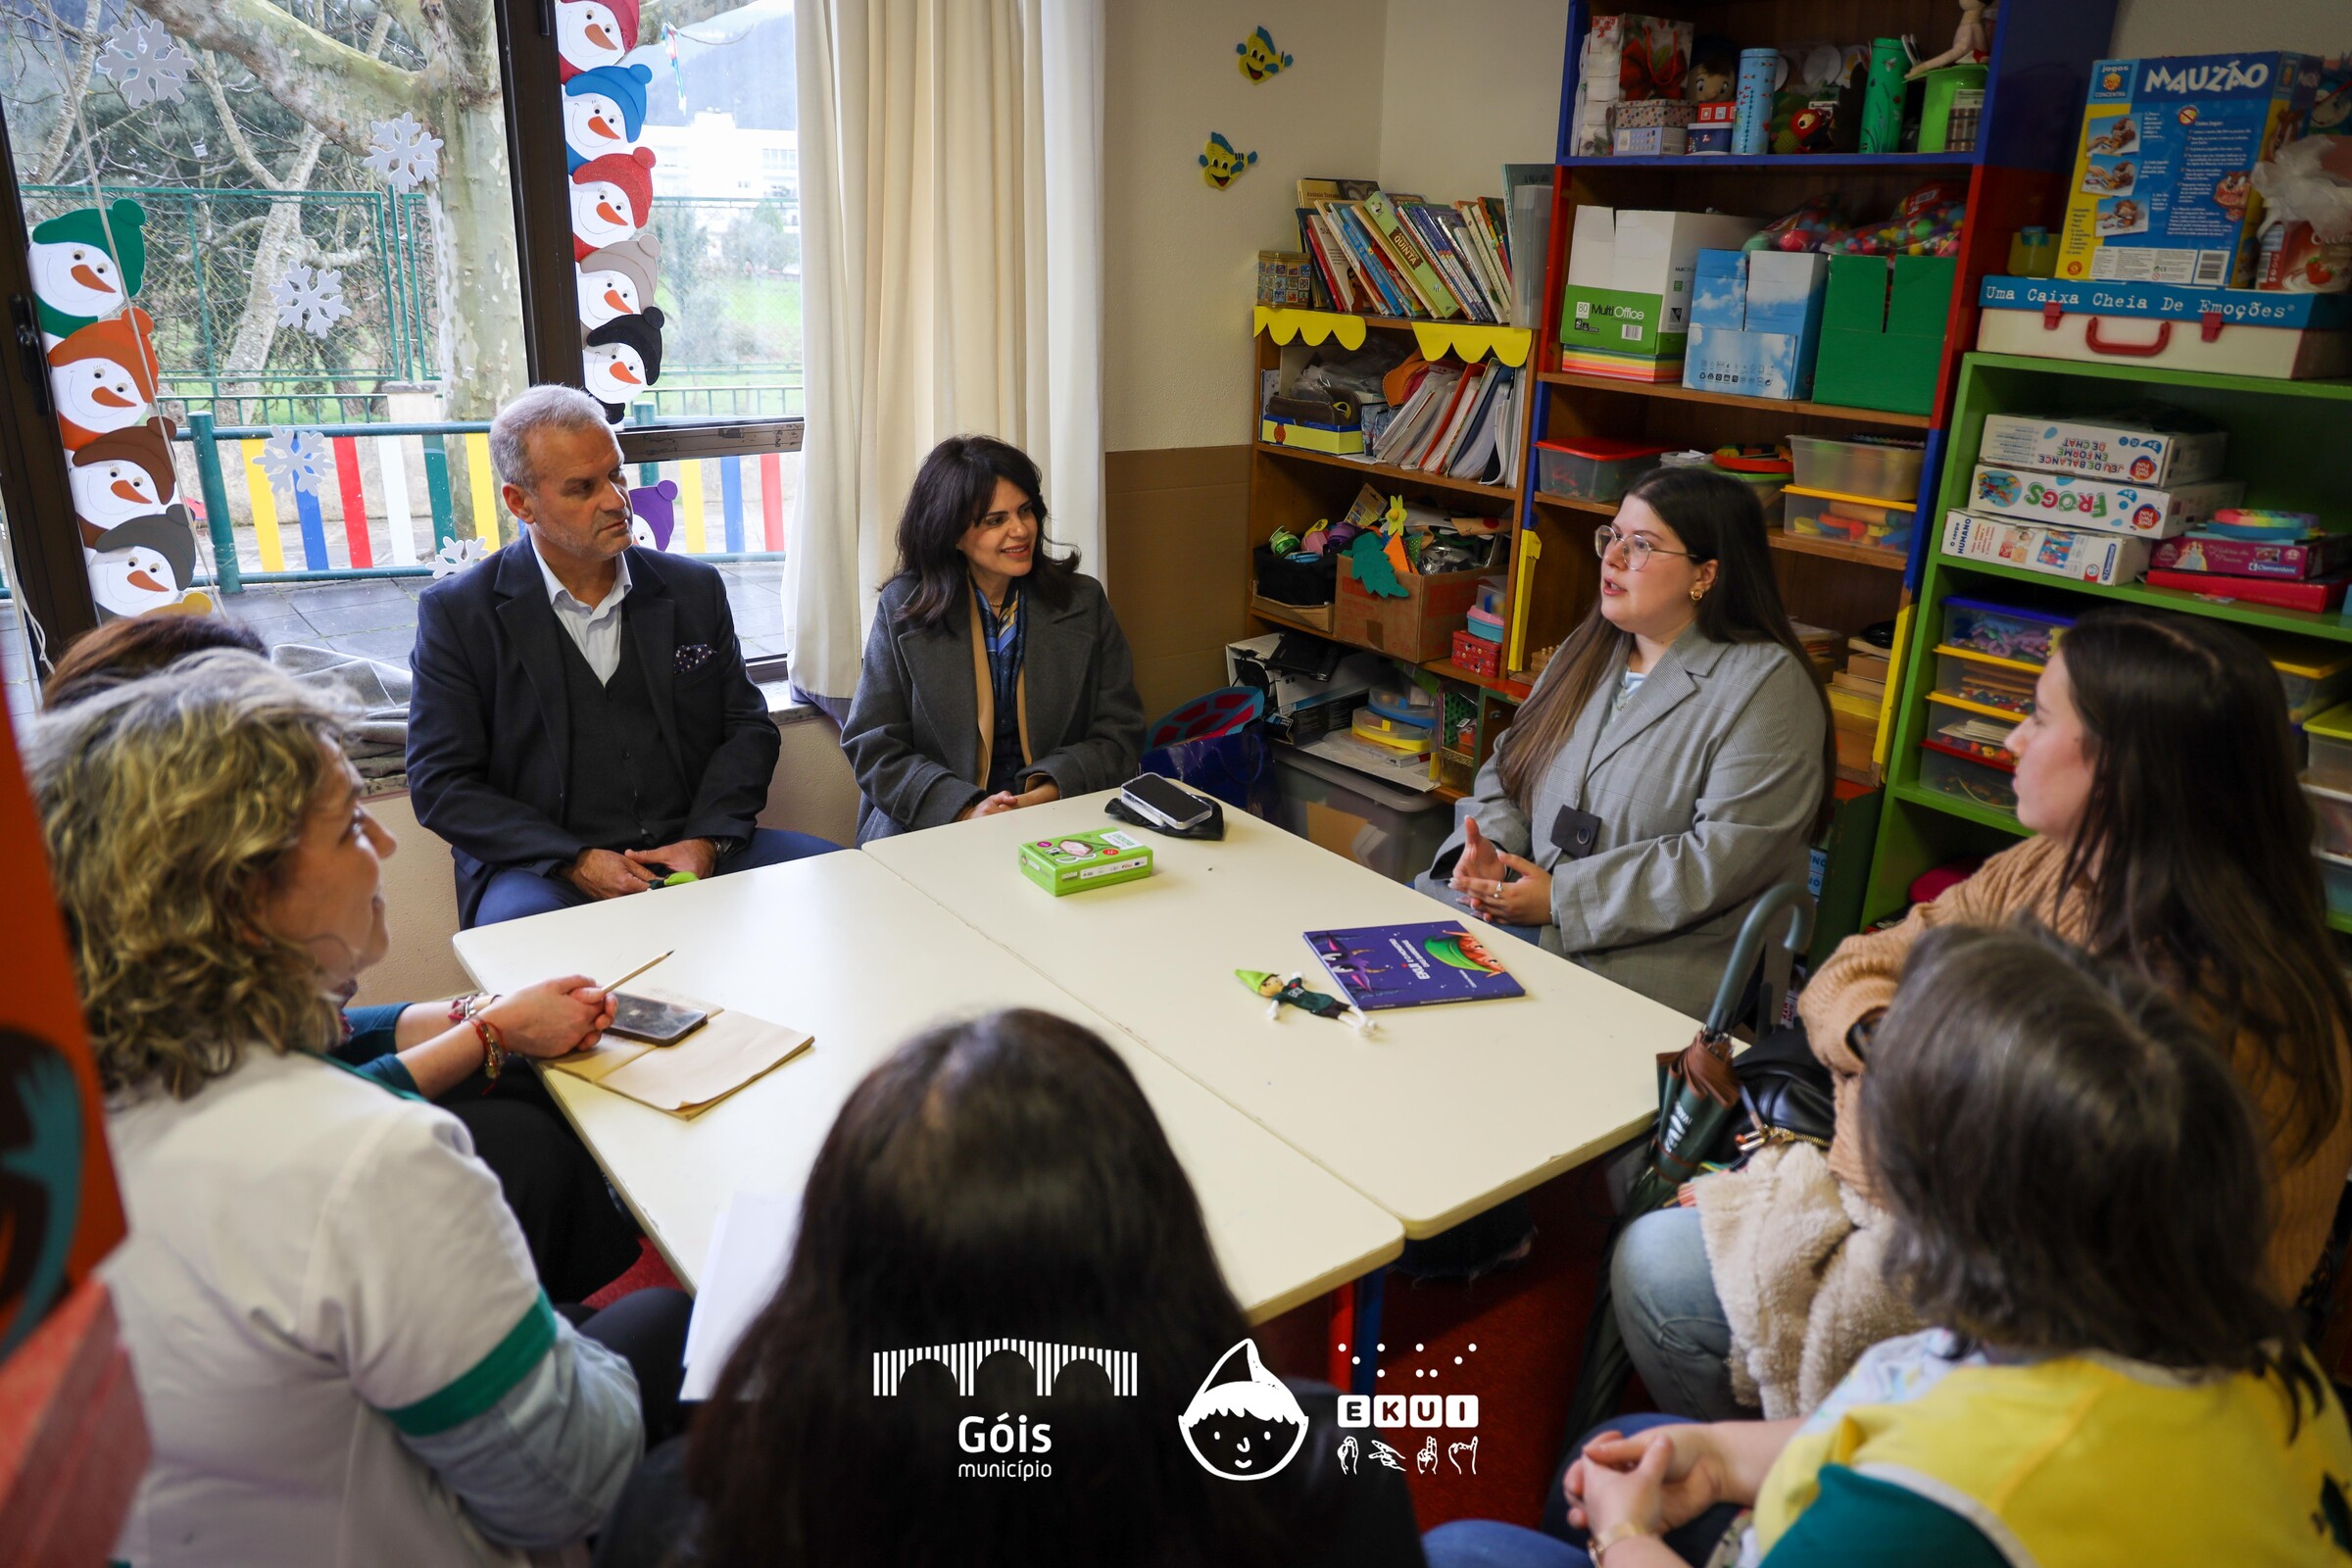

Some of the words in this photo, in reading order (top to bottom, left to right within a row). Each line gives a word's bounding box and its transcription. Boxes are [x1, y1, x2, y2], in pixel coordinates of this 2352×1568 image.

[2144, 60, 2269, 94] MAUZÃO
[1394, 235, 1417, 267] QUINTA
[1985, 285, 2016, 300] Uma
[2028, 288, 2080, 305] Caixa
[2093, 293, 2147, 309] Cheia
[2161, 297, 2183, 312] De
[1578, 304, 1588, 314] 80
[2063, 437, 2089, 450] CHAT
[2092, 442, 2106, 451] DE
[2058, 447, 2093, 460] FORME
[2094, 452, 2108, 462] EN
[2038, 455, 2085, 468] BALANCE
[2087, 461, 2102, 471] DE
[2104, 463, 2125, 473] JEU
[2025, 481, 2107, 518] FROGS
[1957, 518, 1971, 554] HUMANO
[2257, 564, 2296, 574] Clementoni
